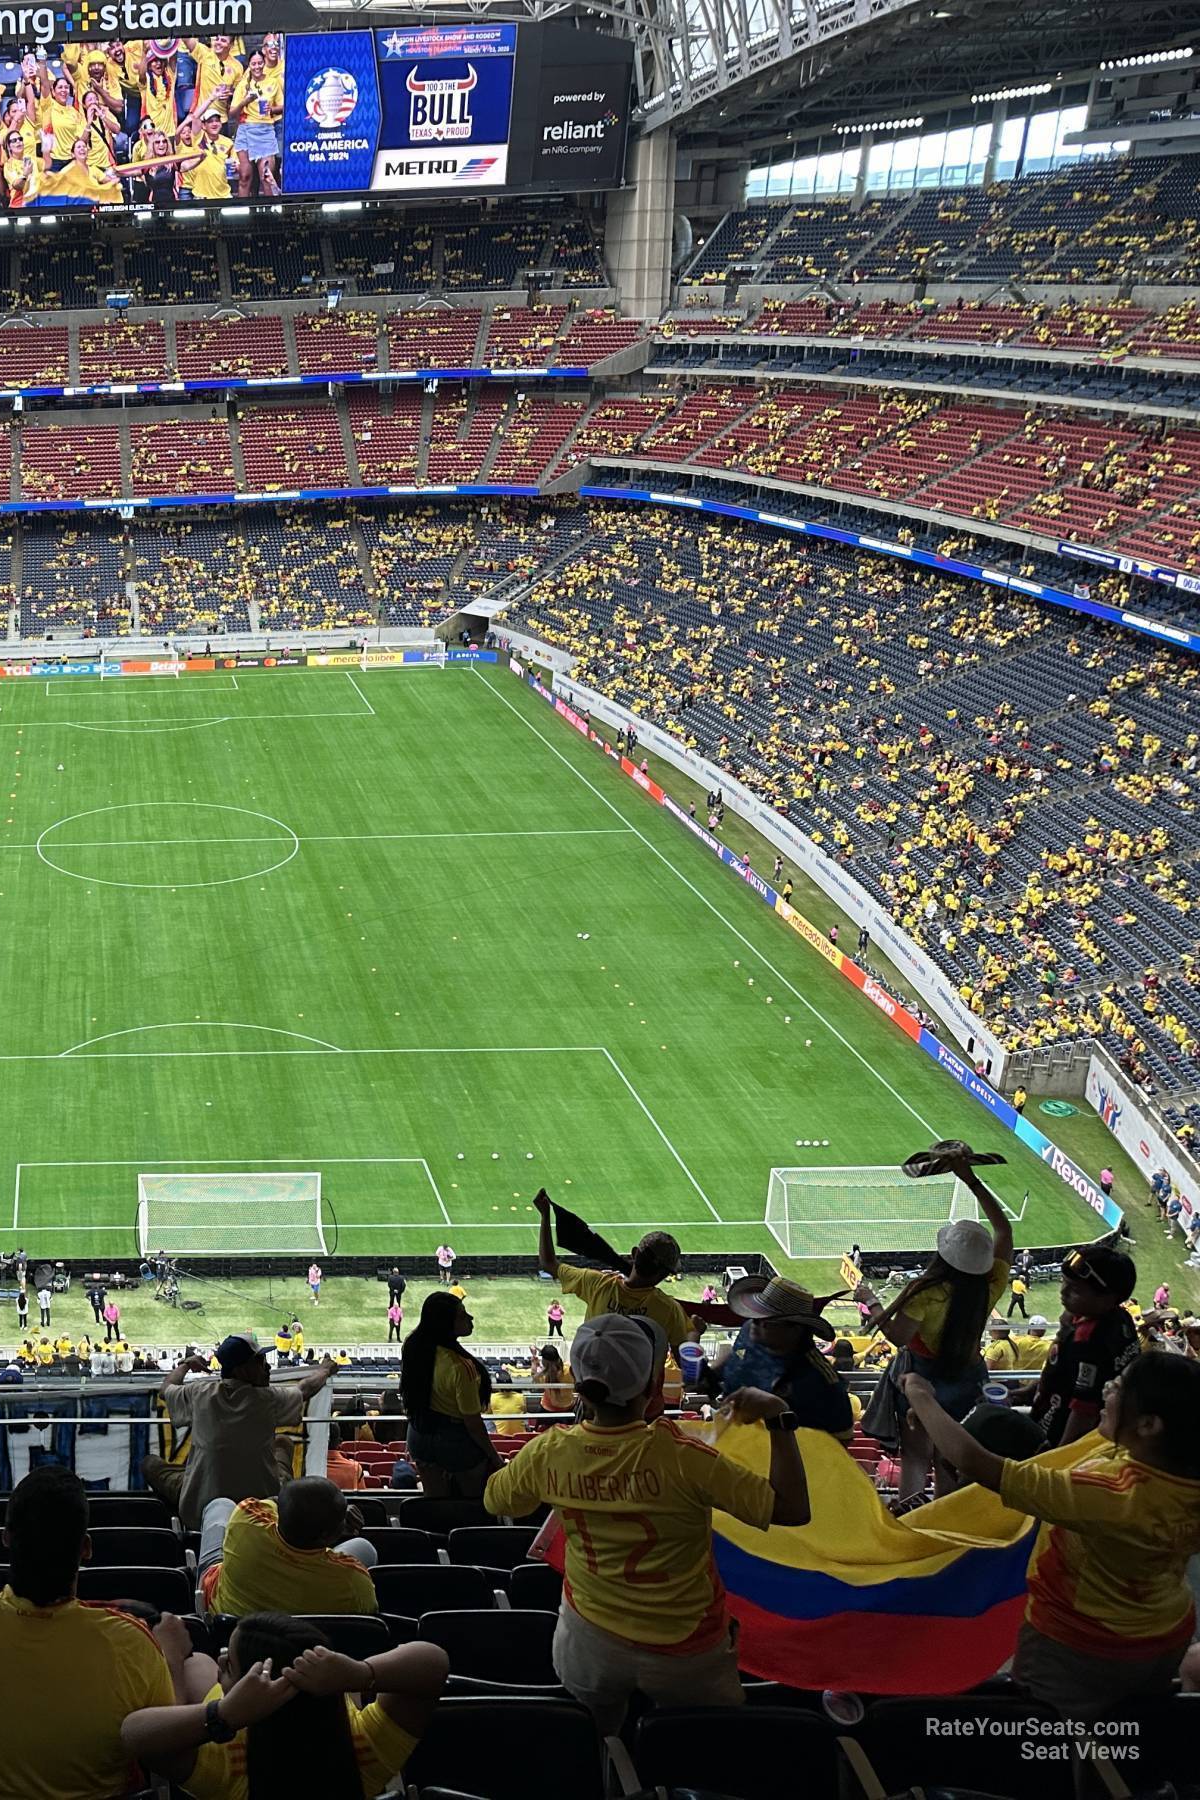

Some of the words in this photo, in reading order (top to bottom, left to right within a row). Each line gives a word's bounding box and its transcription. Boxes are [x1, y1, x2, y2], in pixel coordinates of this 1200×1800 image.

[99, 0, 252, 31] stadium
[445, 82, 456, 91] THE
[553, 91, 591, 104] powered
[593, 90, 606, 102] by
[412, 92, 470, 126] BULL
[411, 128, 433, 138] TEXAS
[445, 126, 469, 136] PROUD
[543, 121, 605, 141] reliant
[289, 141, 319, 152] COPA
[319, 139, 369, 151] AMERICA
[551, 145, 568, 154] NRG
[568, 144, 603, 155] company
[308, 153, 326, 162] USA
[328, 152, 350, 161] 2024
[384, 159, 457, 177] METRO
[333, 655, 375, 664] mercado
[375, 653, 396, 662] libre
[5, 666, 31, 676] TCL
[31, 666, 60, 674] BYD
[63, 665, 90, 673] BYD
[749, 871, 768, 898] ULTRA
[792, 915, 821, 947] mercado
[820, 939, 837, 960] libre
[863, 977, 896, 1016] Betano
[944, 1053, 965, 1075] LATAM
[975, 1084, 996, 1107] DELTA
[1051, 1147, 1105, 1216] Rexona
[547, 1468, 565, 1498] N.
[567, 1468, 661, 1501] LIBERATO
[562, 1508, 670, 1585] 12
